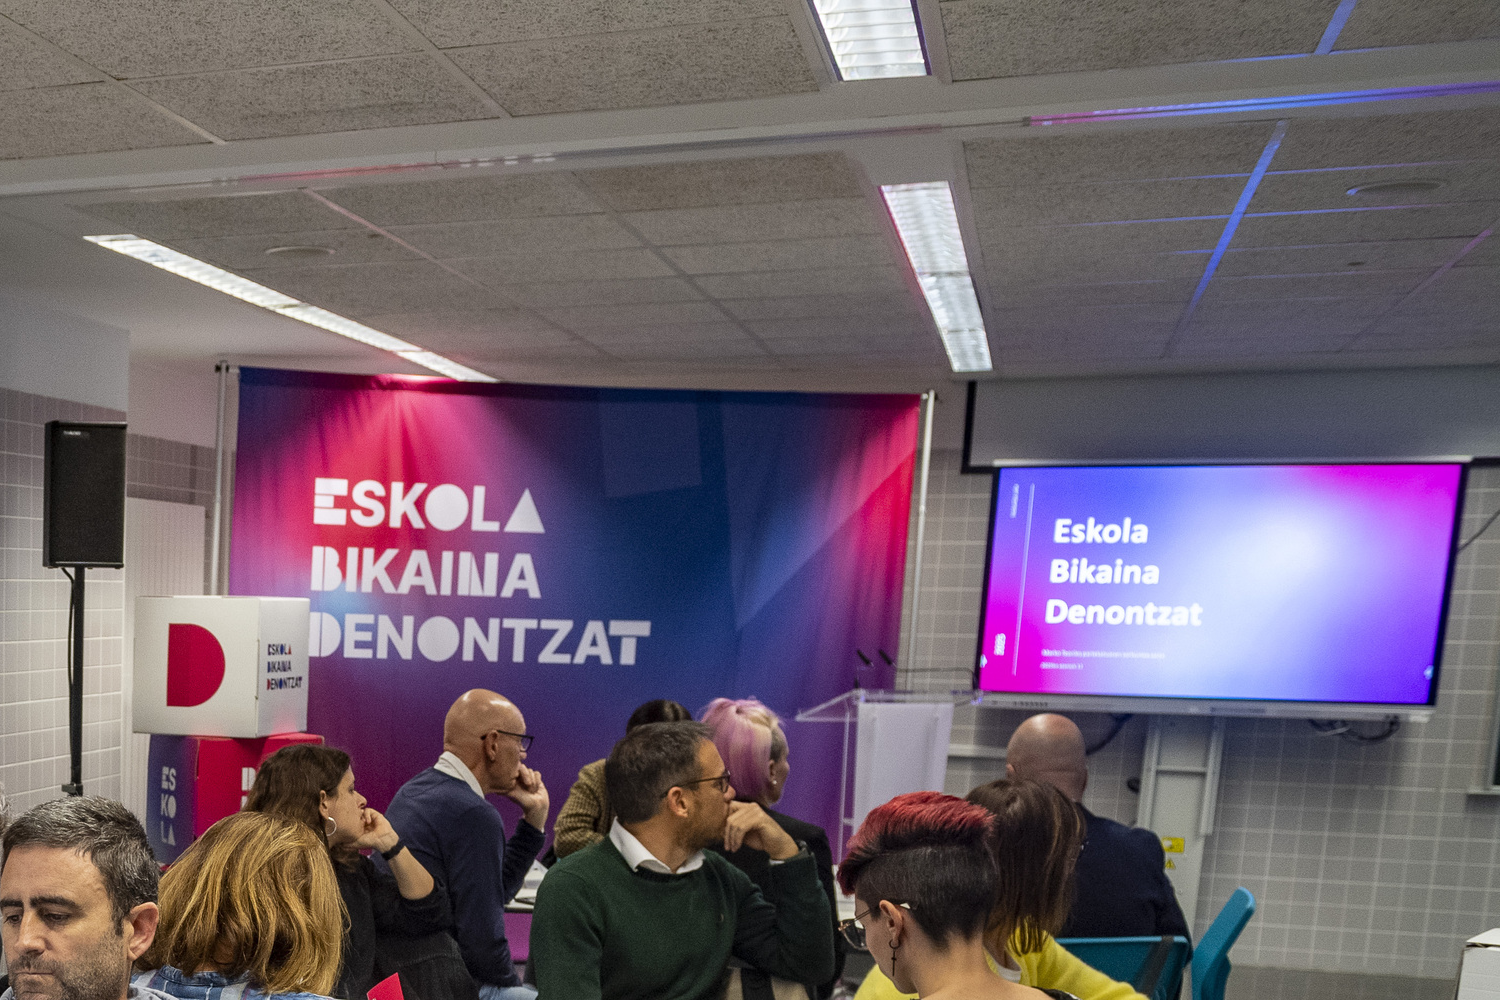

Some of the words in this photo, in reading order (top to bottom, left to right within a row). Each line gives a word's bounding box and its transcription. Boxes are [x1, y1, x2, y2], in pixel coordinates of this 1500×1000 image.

[313, 477, 545, 534] ESKOLA
[1053, 516, 1149, 544] Eskola
[311, 545, 541, 599] BIKAINA
[1050, 558, 1160, 584] Bikaina
[1045, 599, 1203, 626] Denontzat
[267, 643, 292, 656] ESKOLA
[308, 611, 651, 666] DENONTZAT
[267, 676, 302, 690] DENONTZAT
